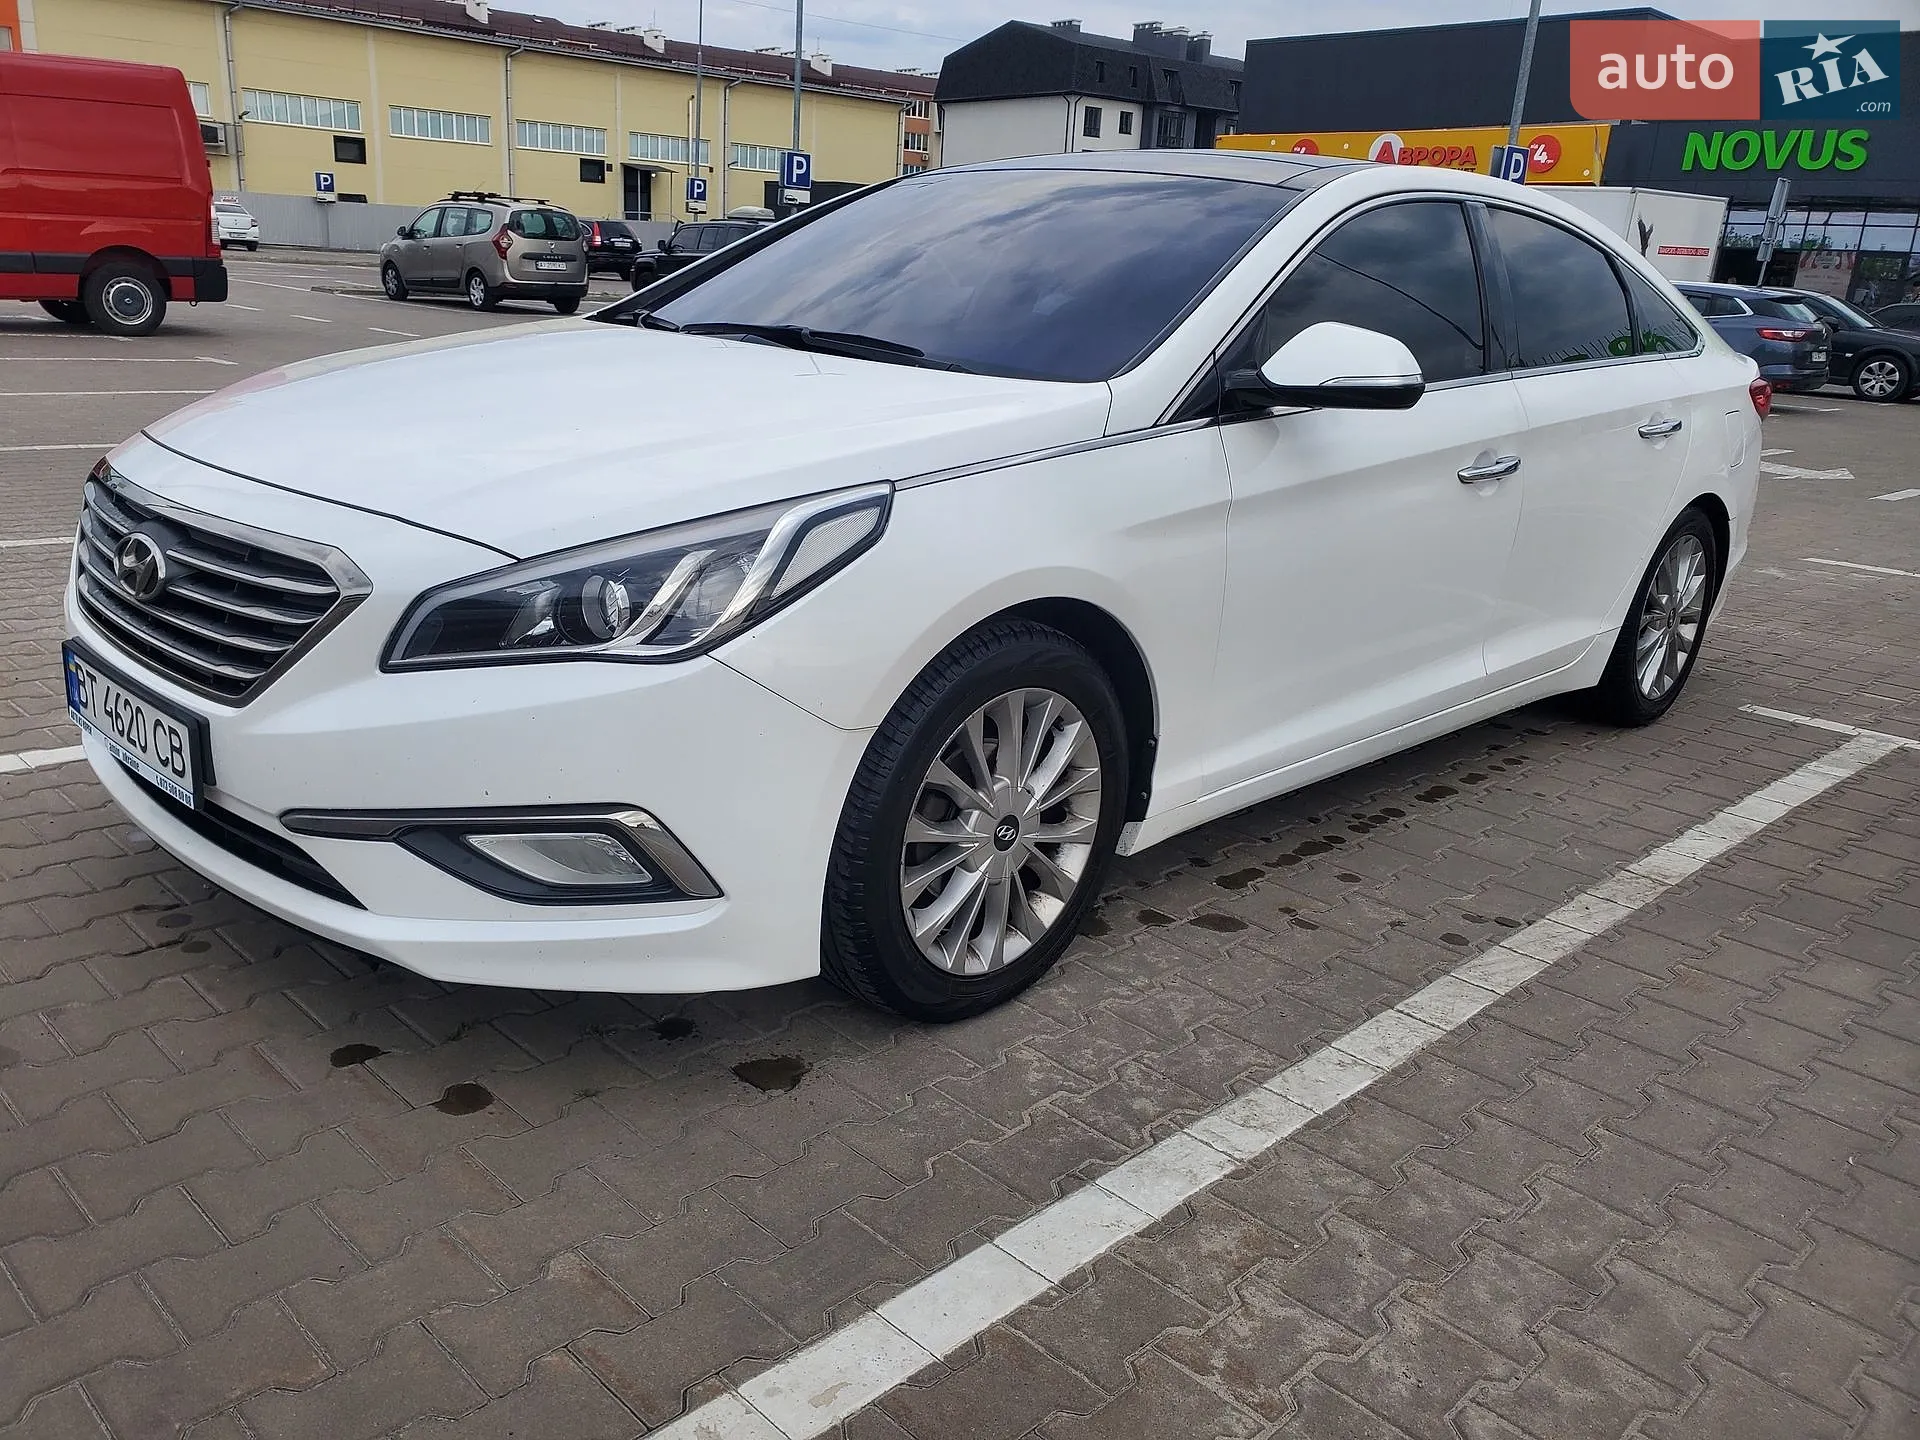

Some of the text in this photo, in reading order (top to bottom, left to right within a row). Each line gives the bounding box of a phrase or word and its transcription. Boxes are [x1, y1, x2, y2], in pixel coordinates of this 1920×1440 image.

[1375, 141, 1477, 165] АВРОРА
[1533, 144, 1548, 164] 4
[1681, 129, 1870, 171] NOVUS
[792, 155, 807, 183] P
[1508, 152, 1524, 182] P
[320, 174, 331, 191] P
[693, 180, 704, 199] P
[75, 661, 186, 779] BT 4620 CB
